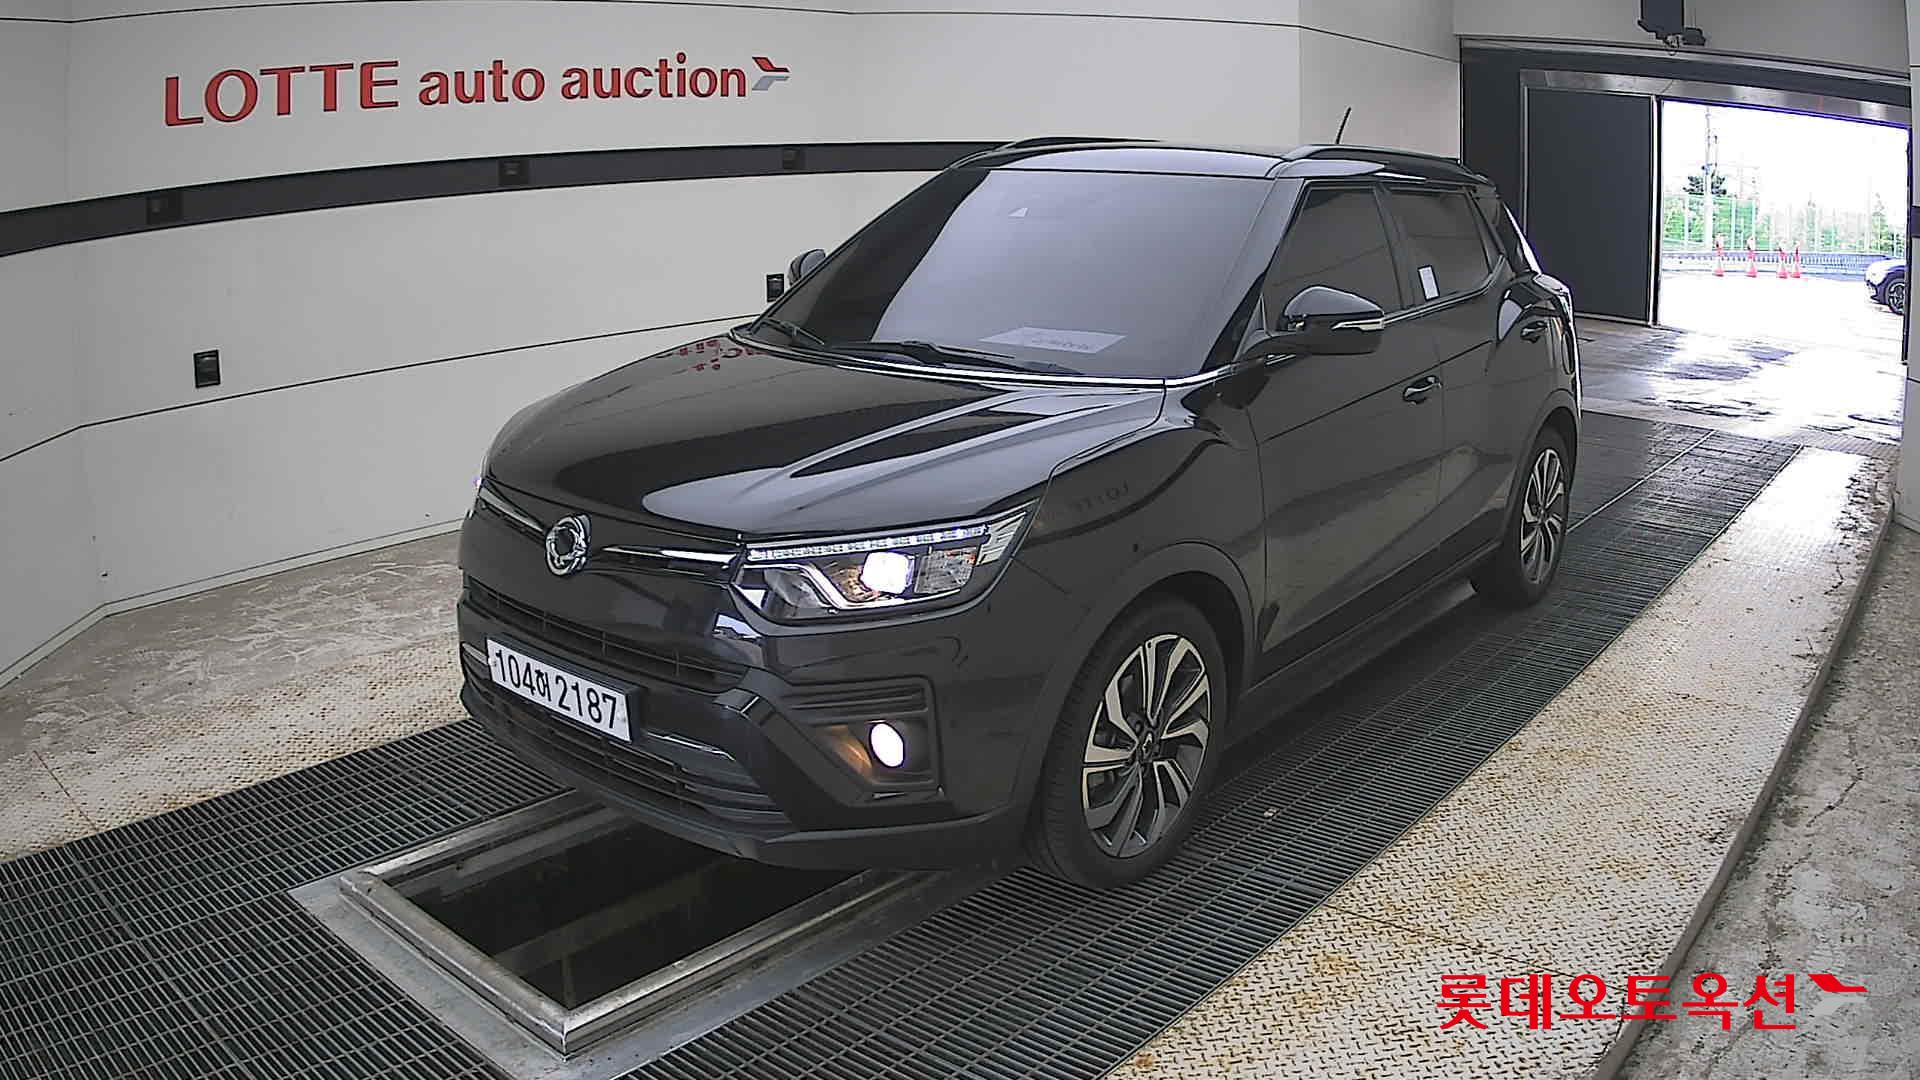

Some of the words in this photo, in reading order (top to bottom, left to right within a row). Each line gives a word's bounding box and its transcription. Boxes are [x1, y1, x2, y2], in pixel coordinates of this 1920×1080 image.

[164, 60, 399, 126] LOTTE
[419, 59, 545, 105] auto
[561, 52, 747, 98] auction
